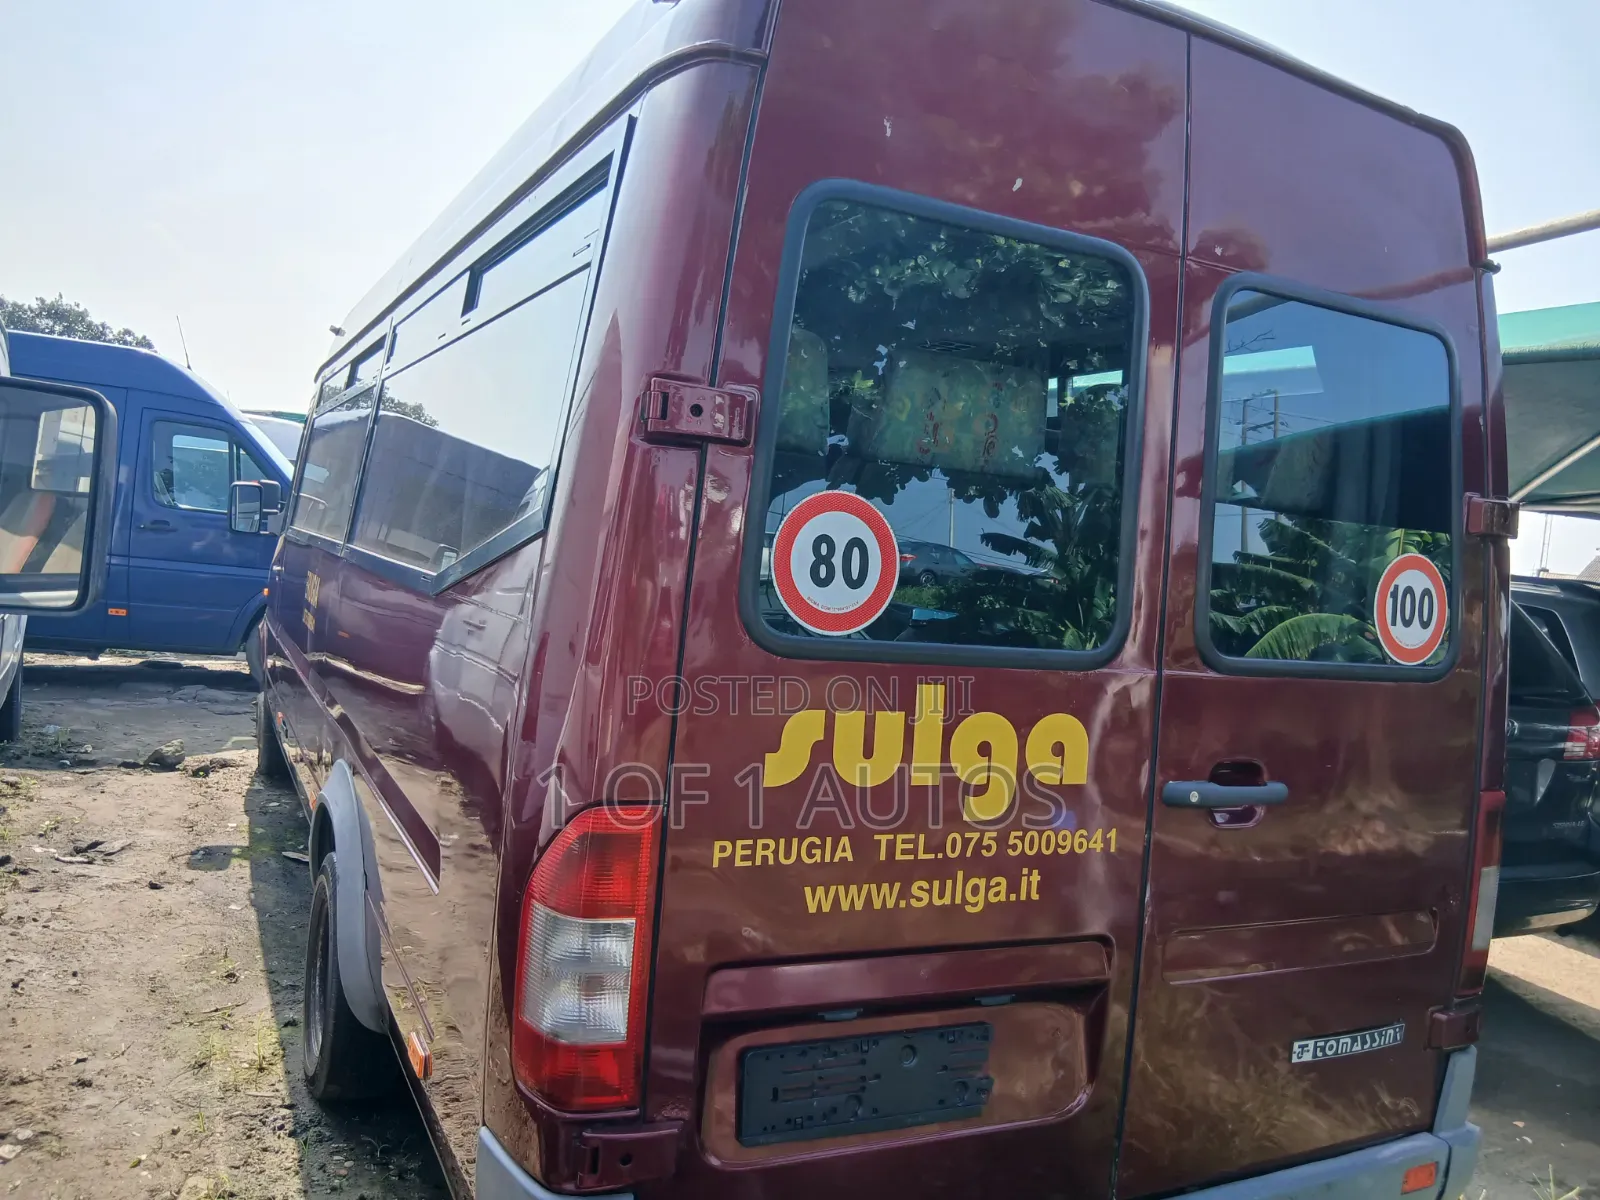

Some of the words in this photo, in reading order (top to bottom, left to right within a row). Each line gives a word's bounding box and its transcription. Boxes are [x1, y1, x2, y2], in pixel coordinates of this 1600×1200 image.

[809, 534, 869, 590] 80
[1390, 584, 1434, 630] 100
[763, 684, 1089, 821] sulga
[712, 836, 853, 867] PERUGIA
[873, 831, 997, 861] TEL.075
[1007, 828, 1118, 857] 5009641
[804, 868, 1041, 913] www.sulga.it
